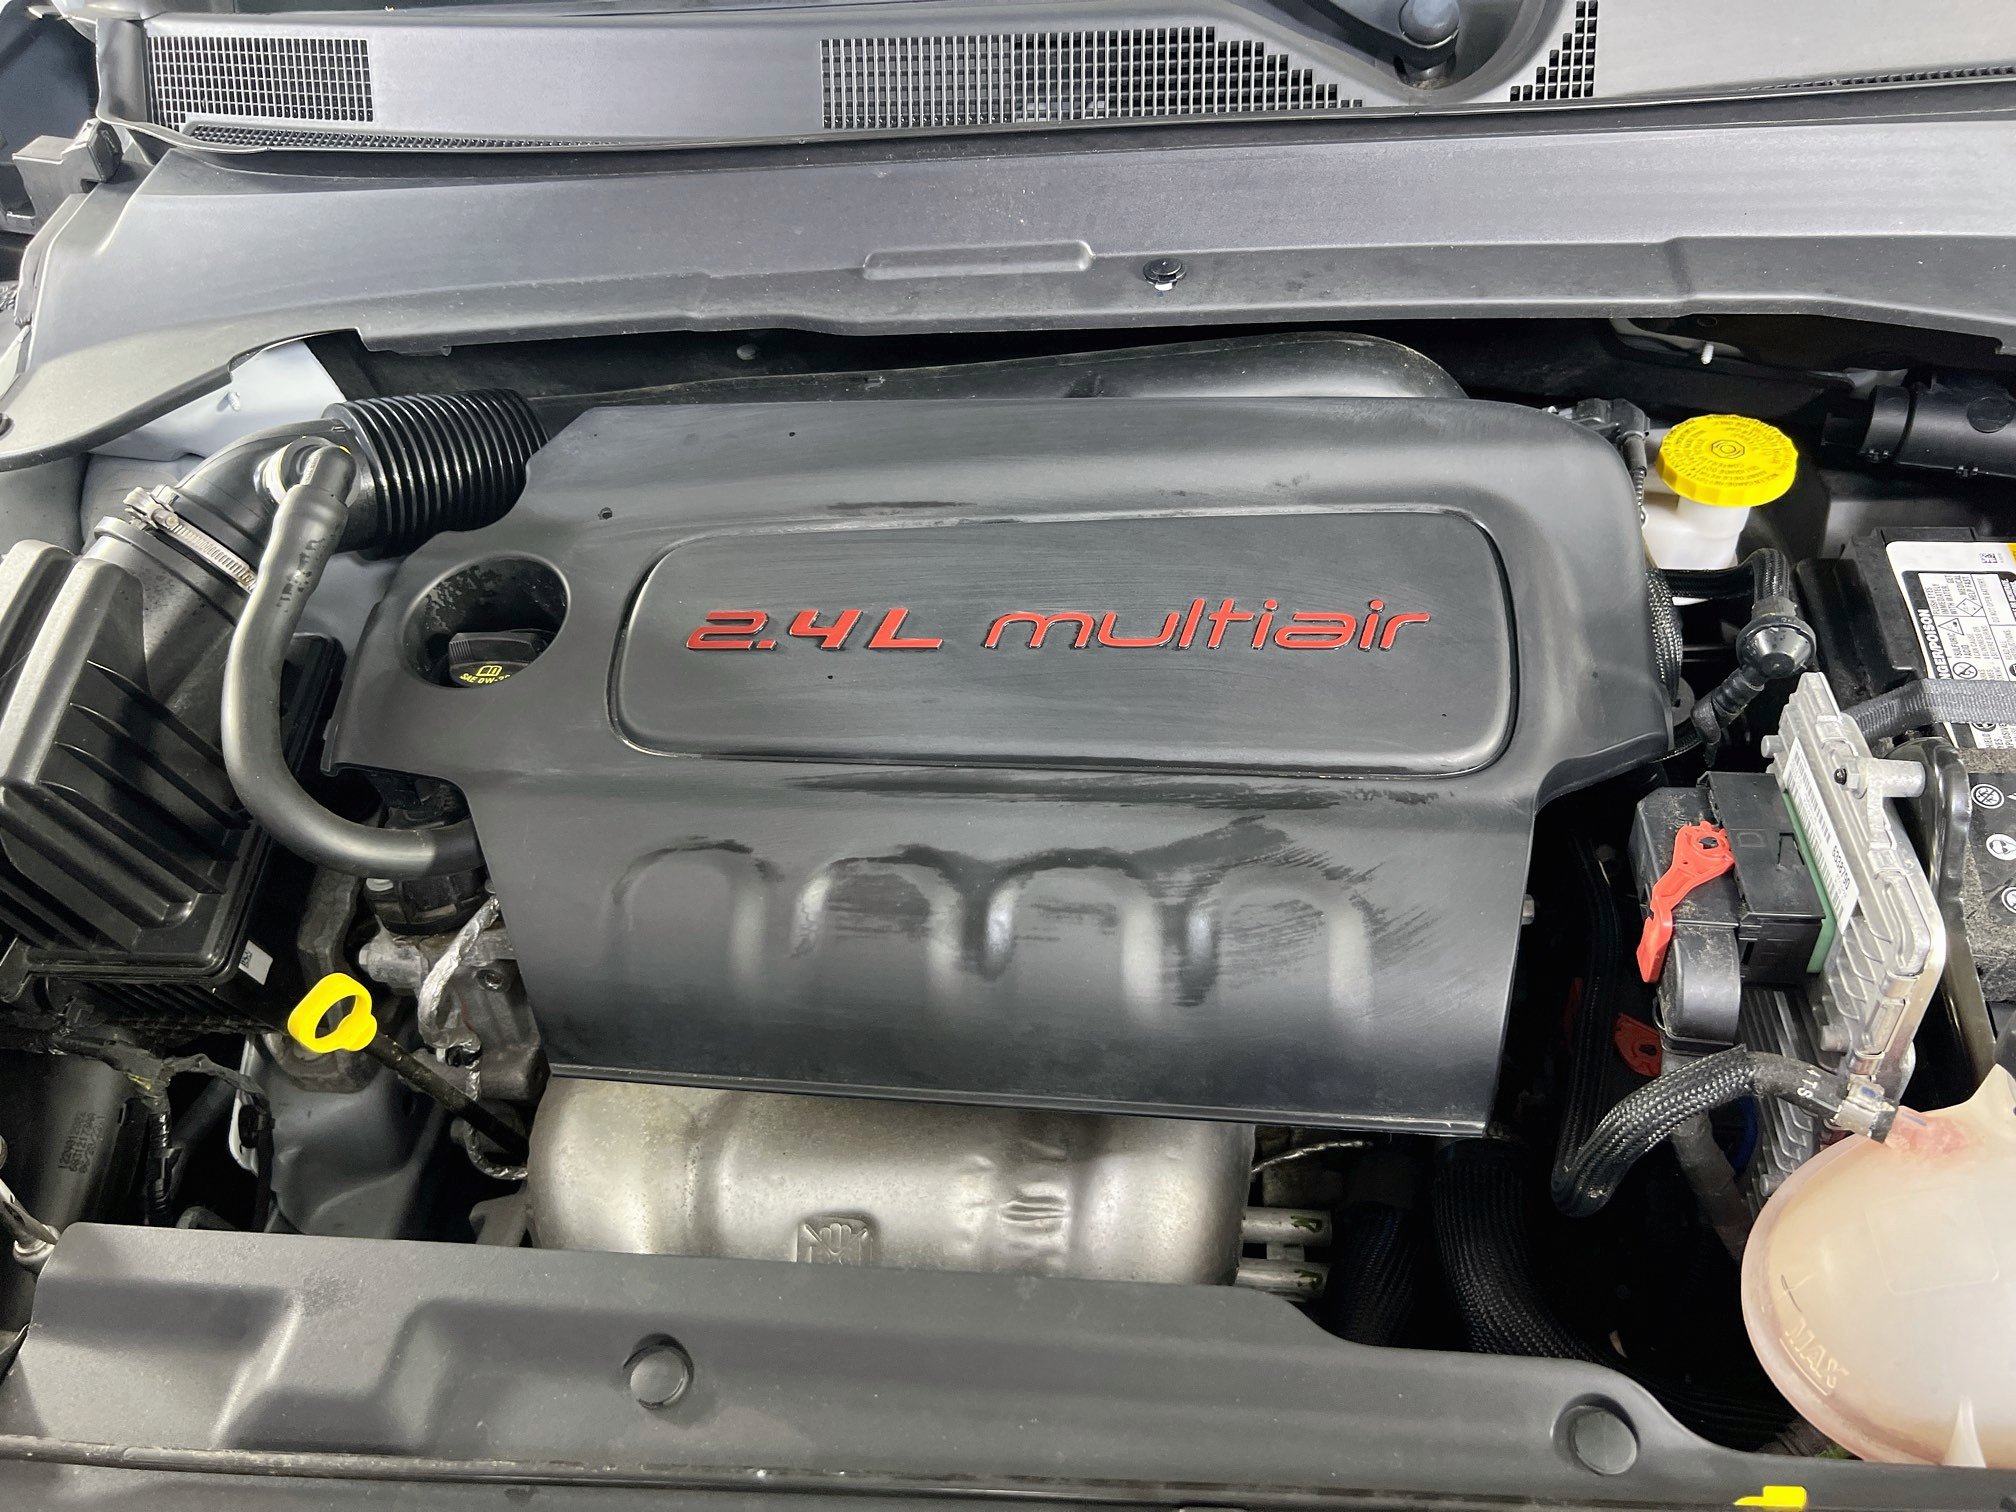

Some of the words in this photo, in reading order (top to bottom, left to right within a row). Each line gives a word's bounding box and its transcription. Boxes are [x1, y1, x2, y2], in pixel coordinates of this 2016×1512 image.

[1924, 587, 1935, 598] EYES
[1952, 575, 1967, 595] MEDICAL
[1932, 584, 1949, 613] IMMEDIATELY
[1965, 588, 1977, 599] HELP
[1928, 600, 1940, 613] FLUSH
[1946, 602, 1957, 613] WITH
[686, 609, 944, 650] 2.4L
[982, 599, 1432, 650] multiair
[1917, 609, 1952, 679] NGER/POISON
[1946, 632, 1962, 655] SULFURIC
[1960, 645, 1971, 655] ACID
[460, 673, 478, 683] SAE
[1785, 1316, 1850, 1389] MAX
